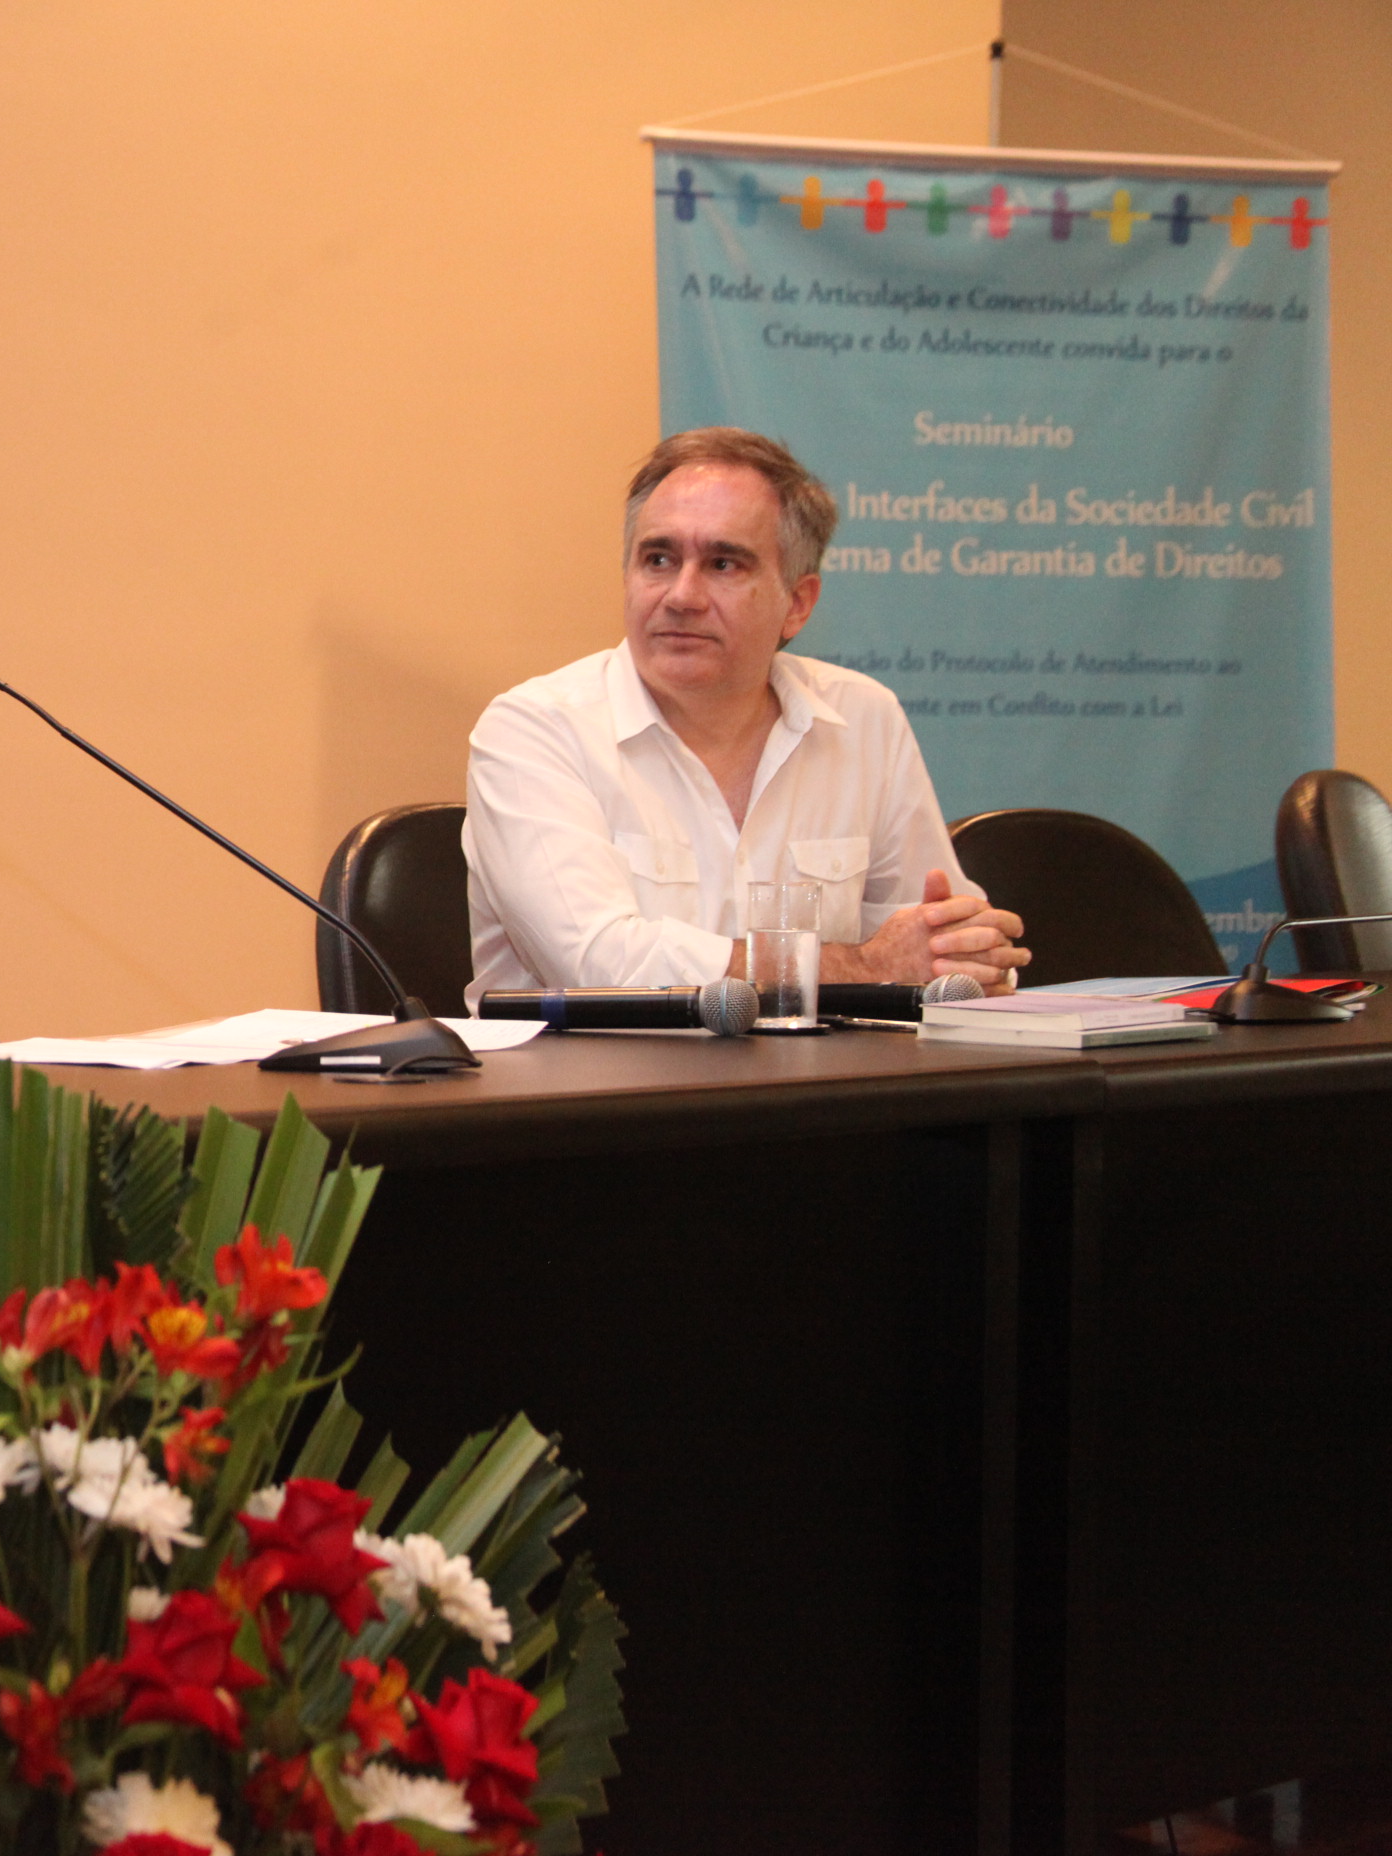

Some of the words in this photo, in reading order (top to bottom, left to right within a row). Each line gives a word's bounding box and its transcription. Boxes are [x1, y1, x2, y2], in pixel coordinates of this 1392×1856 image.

[681, 272, 702, 297] A
[709, 273, 764, 301] Rede
[772, 275, 801, 303] de
[1135, 289, 1179, 319] dos
[762, 322, 854, 357] Criança
[859, 335, 874, 351] e
[879, 325, 910, 352] do
[916, 327, 1055, 358] Adolescente
[1061, 334, 1149, 361] convida
[1158, 344, 1210, 370] para
[913, 410, 1075, 449] Seminário
[846, 479, 1008, 523] Interfaces
[1015, 483, 1057, 525] da
[1065, 485, 1232, 528] Sociedade
[1239, 487, 1315, 528] Civil
[900, 532, 943, 575] de
[950, 535, 1096, 577] Garantia
[1104, 535, 1147, 578] de
[1154, 541, 1285, 581] Direitos
[896, 647, 927, 673] do
[930, 650, 1035, 674] Protocolo
[1039, 650, 1067, 675] de
[1072, 652, 1212, 677] Atendimento
[947, 700, 983, 716] em
[986, 691, 1076, 718] Conflito
[1149, 696, 1185, 718] Lei
